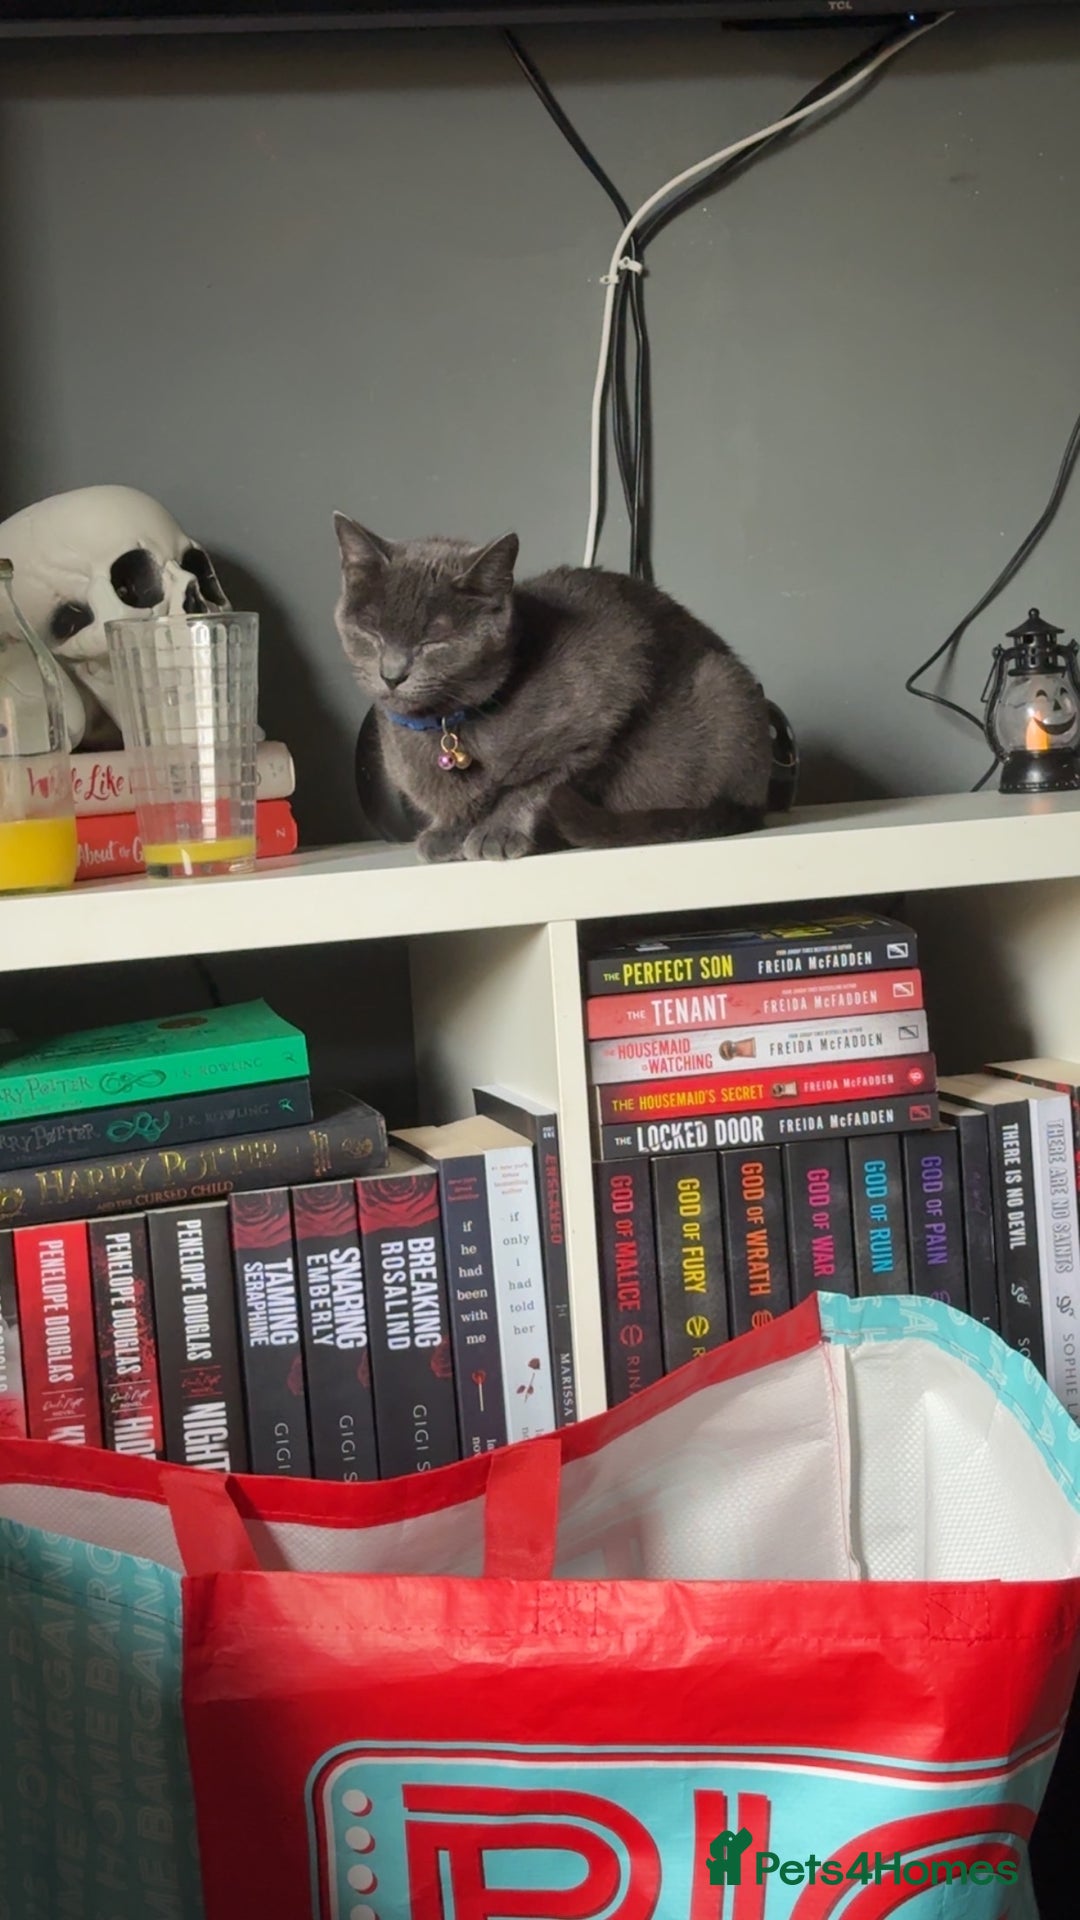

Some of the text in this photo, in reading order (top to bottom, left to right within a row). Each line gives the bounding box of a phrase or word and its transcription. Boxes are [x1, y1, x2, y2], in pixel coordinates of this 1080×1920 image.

[828, 1, 853, 10] TCL
[84, 764, 125, 801] Like
[603, 955, 733, 986] THE PERFECT SON
[758, 951, 872, 974] FREIDA McFADDEN
[627, 994, 727, 1026] THE TENANT
[764, 990, 877, 1014] FREIDA McFADDEN
[618, 1038, 690, 1060] HOUSEMAID
[770, 1041, 812, 1056] FREIDA
[821, 1033, 882, 1050] McFADDEN
[200, 1057, 263, 1076] ROWLING
[648, 1054, 712, 1074] WATCHING
[26, 1074, 93, 1101] POTTER
[612, 1085, 763, 1112] THE HOUSEMAID'S SECRET
[804, 1074, 894, 1092] FREIDA McFADDEN
[205, 1103, 270, 1123] ROWLING
[779, 1109, 894, 1133] FREIDA McFADDEN
[31, 1123, 95, 1150] POTTER
[614, 1115, 764, 1152] THE LOCKED DOOR
[135, 1188, 187, 1206] CURSED
[191, 1180, 233, 1197] CHILD
[1001, 1122, 1026, 1250] THERE IS NO DEVIL
[1047, 1119, 1073, 1274] THERE ARE NO SAINTS
[462, 1220, 473, 1232] if
[510, 1212, 520, 1222] if
[807, 1168, 835, 1277] GOD OF WAR
[864, 1160, 894, 1273] GOD OF RUIN
[921, 1155, 948, 1265] GOD OF PAIN
[503, 1234, 530, 1247] only
[610, 1175, 641, 1312] GOD OF MALICE
[677, 1177, 706, 1294] GOD OF FURY
[741, 1162, 772, 1296] GOD OF WRATH
[176, 1219, 208, 1292] PENELOPE
[461, 1244, 477, 1255] he
[39, 1239, 69, 1313] PENELOPE
[105, 1232, 136, 1306] PENELOPE
[458, 1264, 483, 1278] had
[508, 1278, 532, 1291] had
[243, 1261, 269, 1347] SERAPHINE
[264, 1257, 299, 1346] TAMING
[306, 1253, 334, 1346] EMBERLY
[329, 1247, 368, 1349] SNARING
[380, 1241, 411, 1350] ROSALIND
[407, 1236, 443, 1348] BREAKING
[457, 1288, 488, 1301] been
[510, 1300, 535, 1313] told
[182, 1294, 213, 1361] DOUGLAS
[460, 1309, 488, 1323] with
[513, 1323, 535, 1335] her
[44, 1314, 74, 1384] DOUGLAS
[111, 1307, 142, 1376] DOUGLAS
[466, 1333, 486, 1345] me
[1063, 1333, 1078, 1396] SOPHIE
[560, 1352, 574, 1416] MARISSA
[182, 1401, 232, 1474] NIGHT
[339, 1415, 356, 1461] GIGI
[413, 1404, 429, 1450] GIGI
[274, 1422, 292, 1470] GIGI
